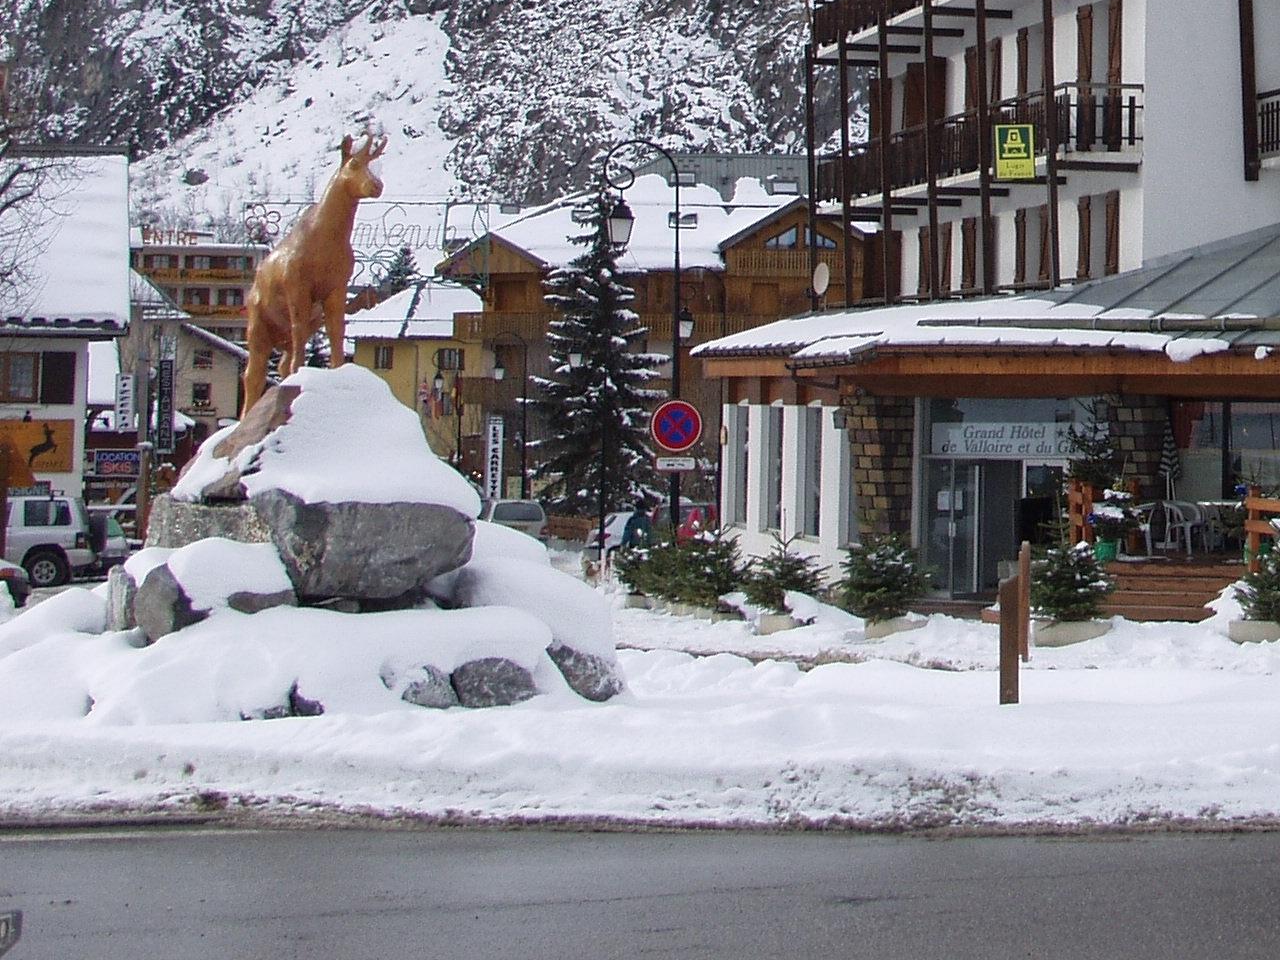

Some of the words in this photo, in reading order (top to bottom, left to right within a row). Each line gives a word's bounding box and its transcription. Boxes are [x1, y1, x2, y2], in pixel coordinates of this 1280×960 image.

[160, 361, 171, 448] RESTAURANT
[963, 426, 1004, 439] Grand
[1010, 425, 1047, 439] Hôtel
[942, 440, 957, 453] de
[965, 440, 1013, 453] Valloire
[1018, 442, 1030, 453] et
[1036, 441, 1052, 453] du
[96, 452, 140, 462] LOCATION
[103, 462, 132, 474] SKIS
